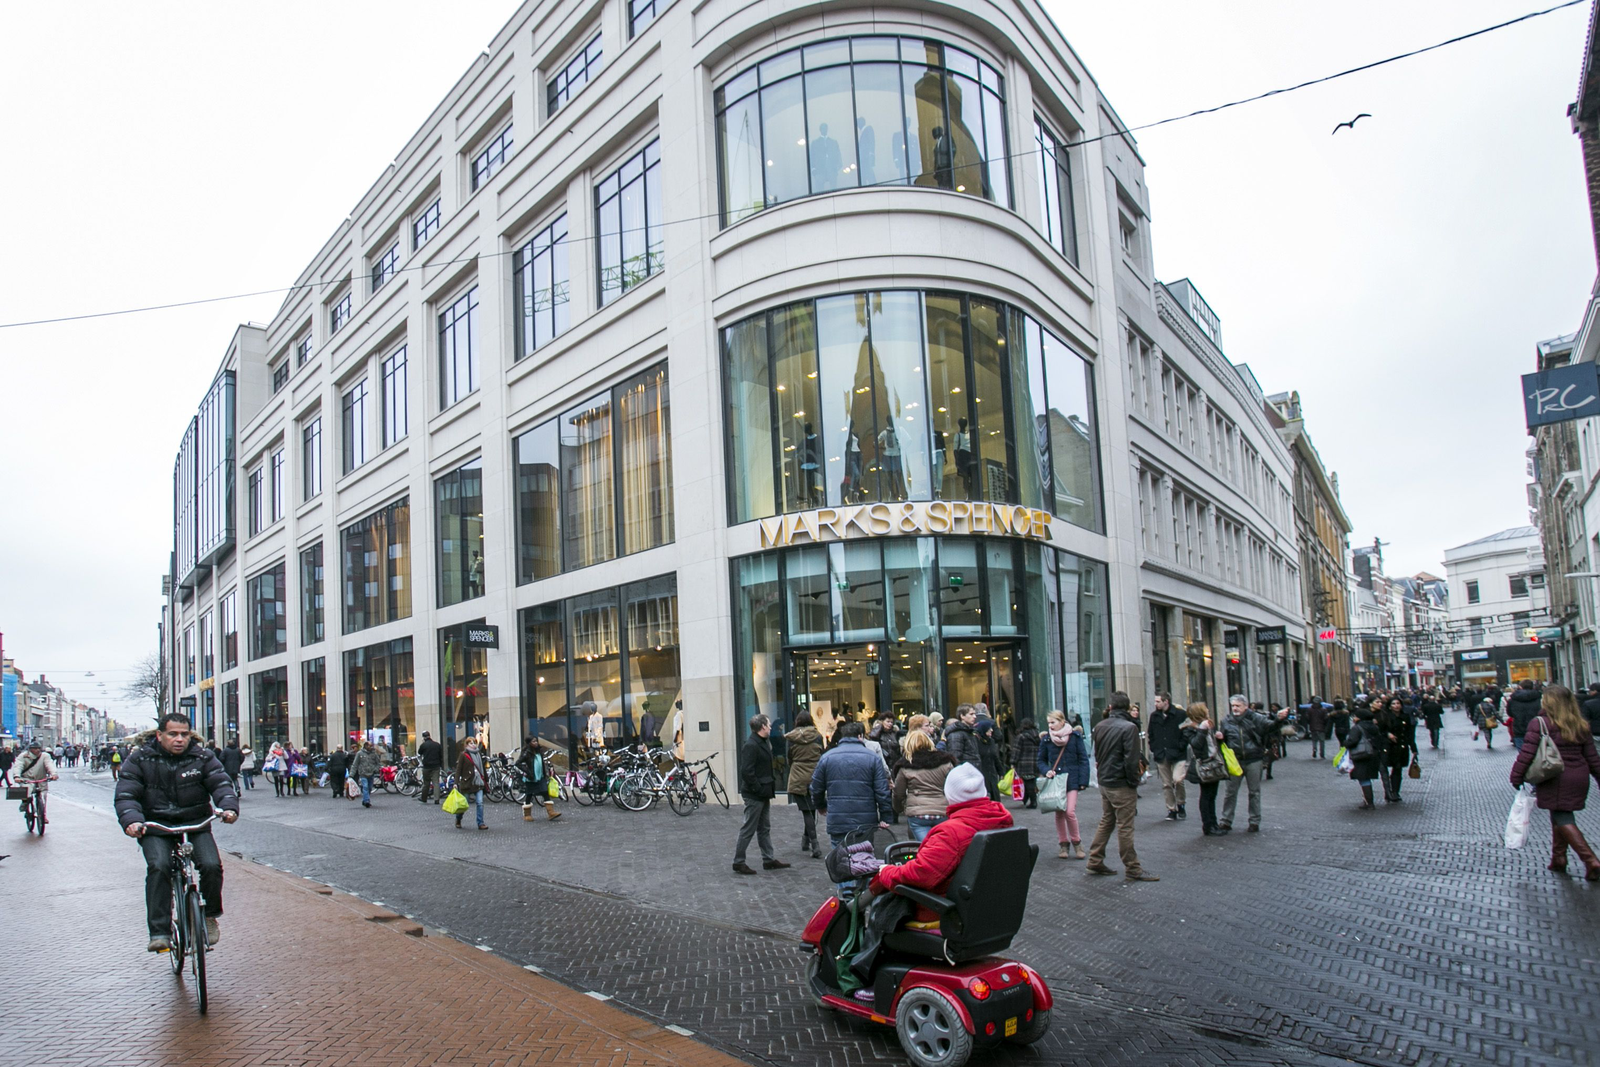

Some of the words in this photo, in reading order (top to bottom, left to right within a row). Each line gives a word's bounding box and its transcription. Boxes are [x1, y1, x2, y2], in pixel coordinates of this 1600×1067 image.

[758, 502, 892, 547] MARKS
[898, 501, 923, 533] &
[925, 501, 1054, 541] SPENCER
